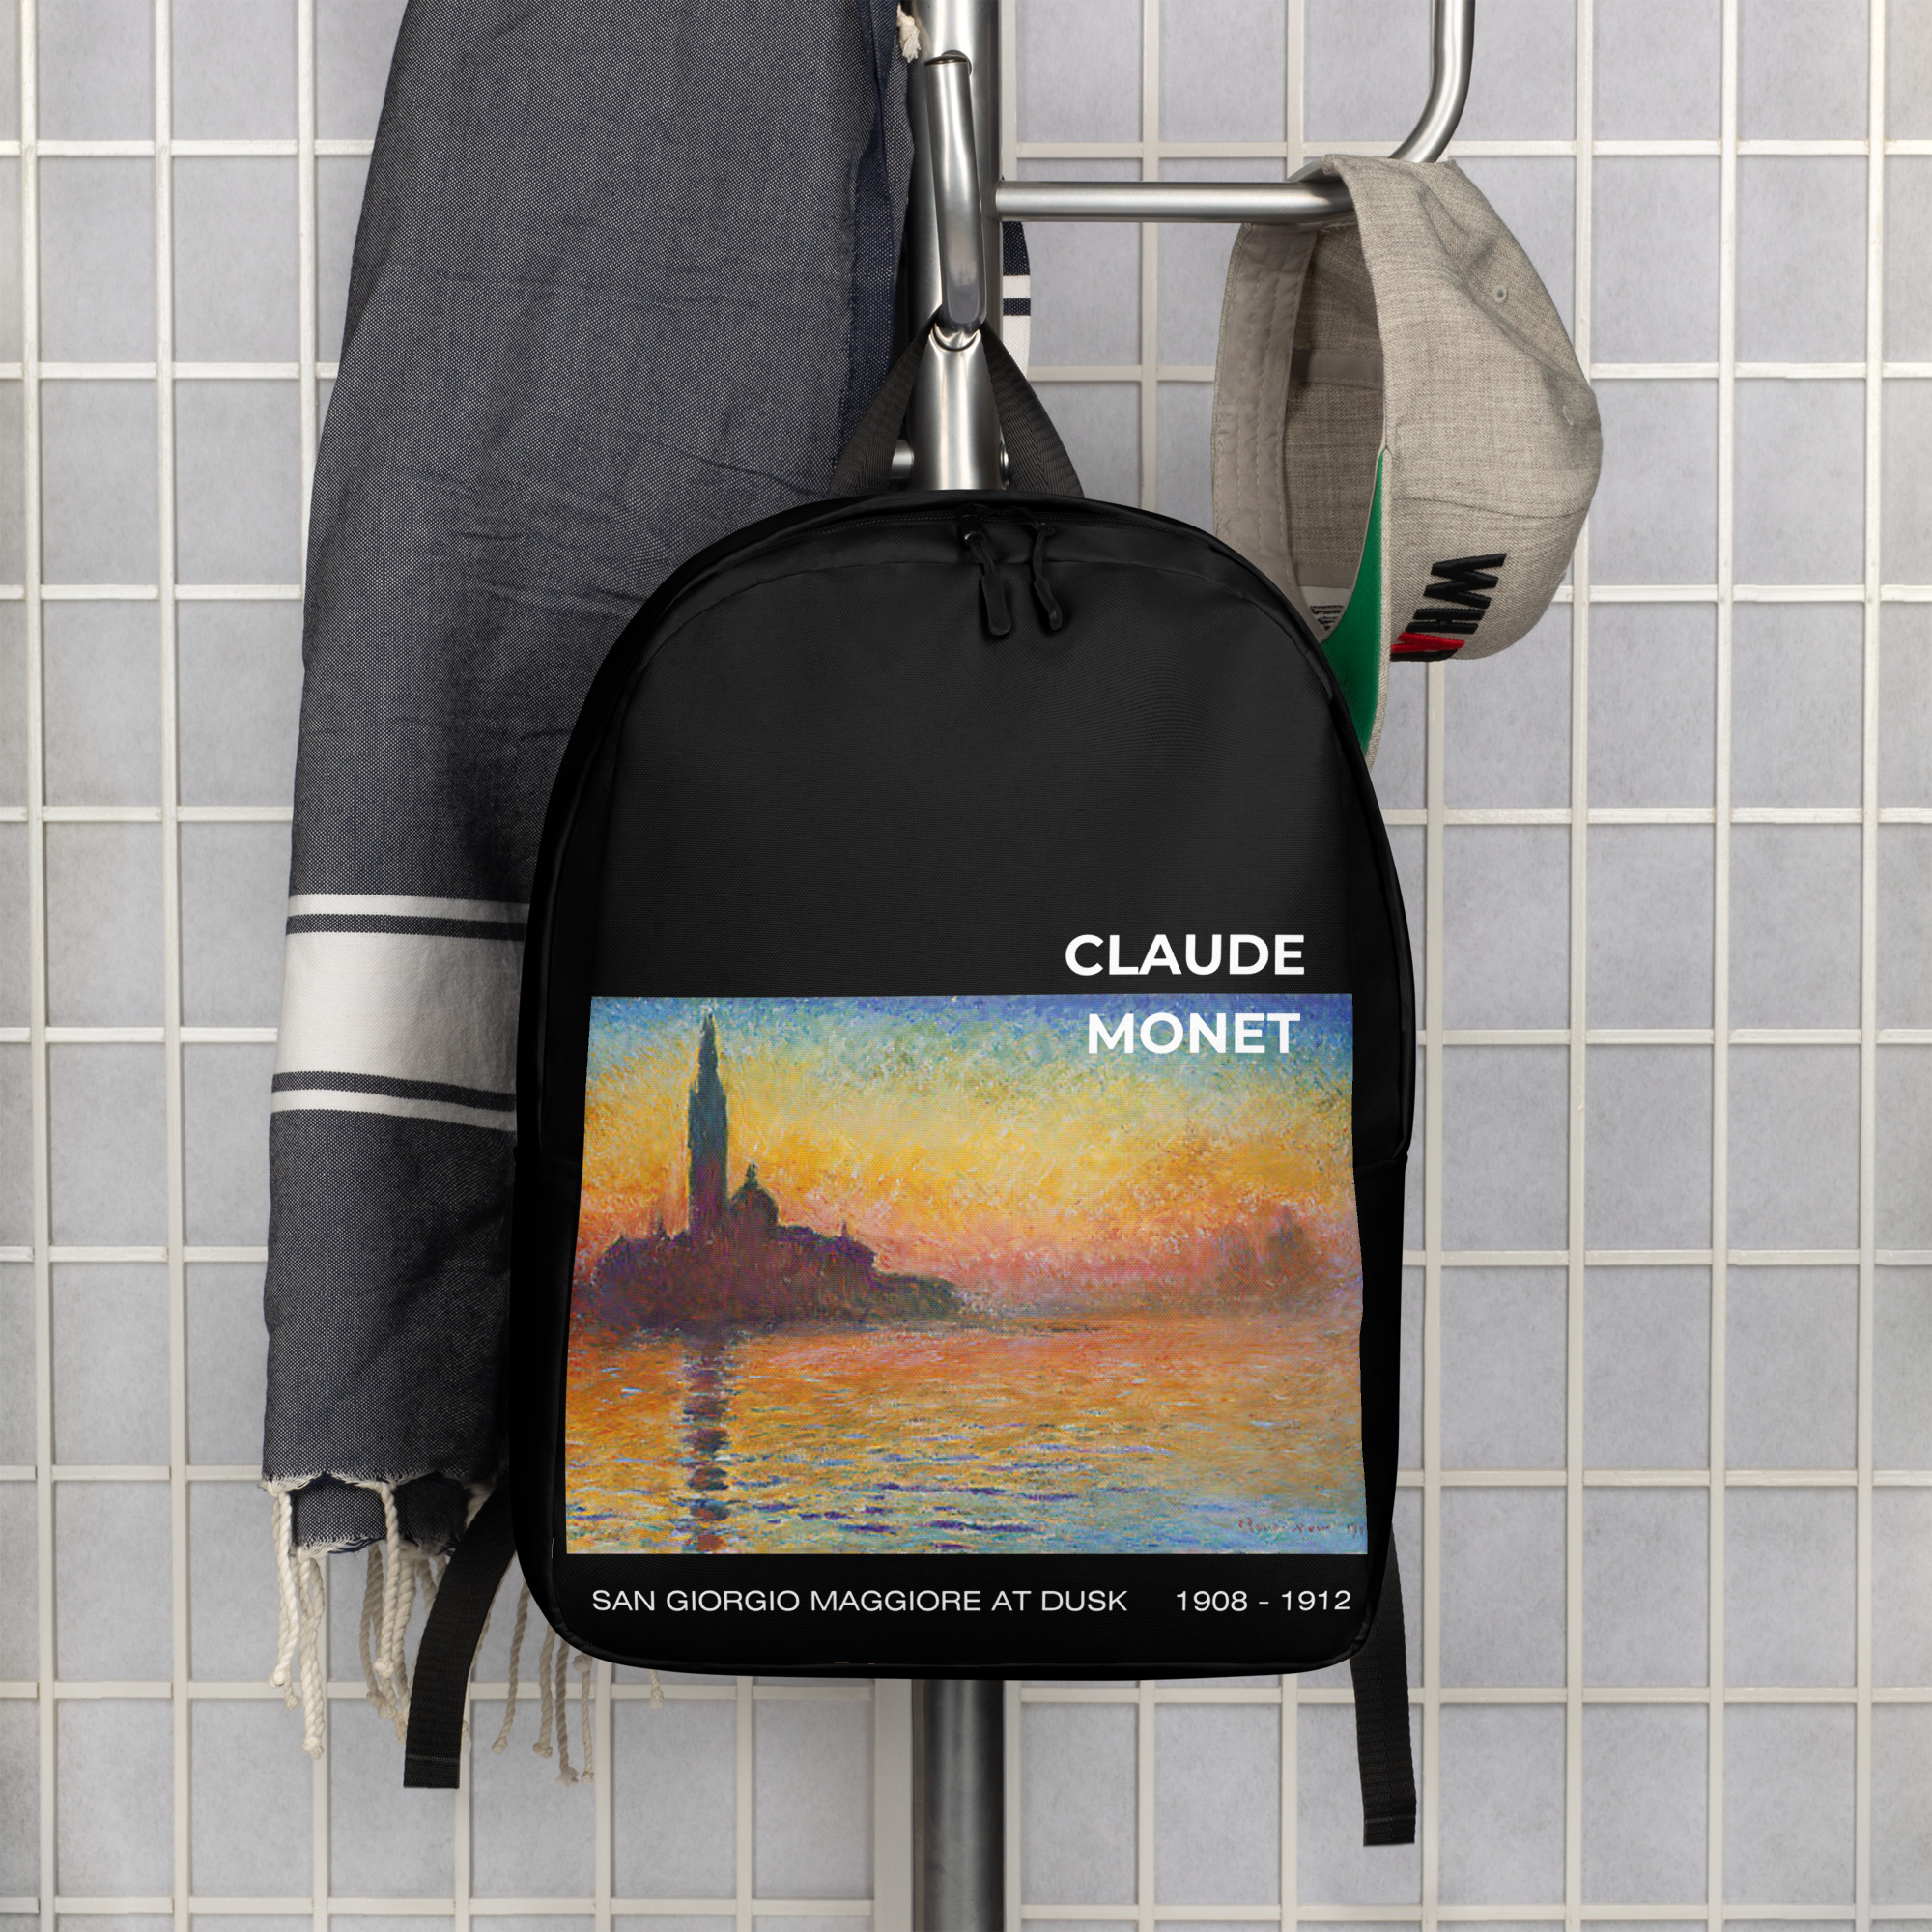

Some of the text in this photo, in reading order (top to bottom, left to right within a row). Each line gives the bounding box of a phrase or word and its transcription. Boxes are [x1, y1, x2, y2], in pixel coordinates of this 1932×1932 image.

[1065, 933, 1305, 977] CLAUDE
[1088, 1011, 1301, 1055] MONET
[592, 1589, 655, 1612] SAN
[666, 1590, 800, 1612] GIORGIO
[810, 1590, 981, 1612] MAGGIORE
[991, 1590, 1032, 1611] AT
[1041, 1590, 1128, 1612] DUSK
[1176, 1590, 1248, 1612] 1908
[1281, 1590, 1351, 1611] 1912
